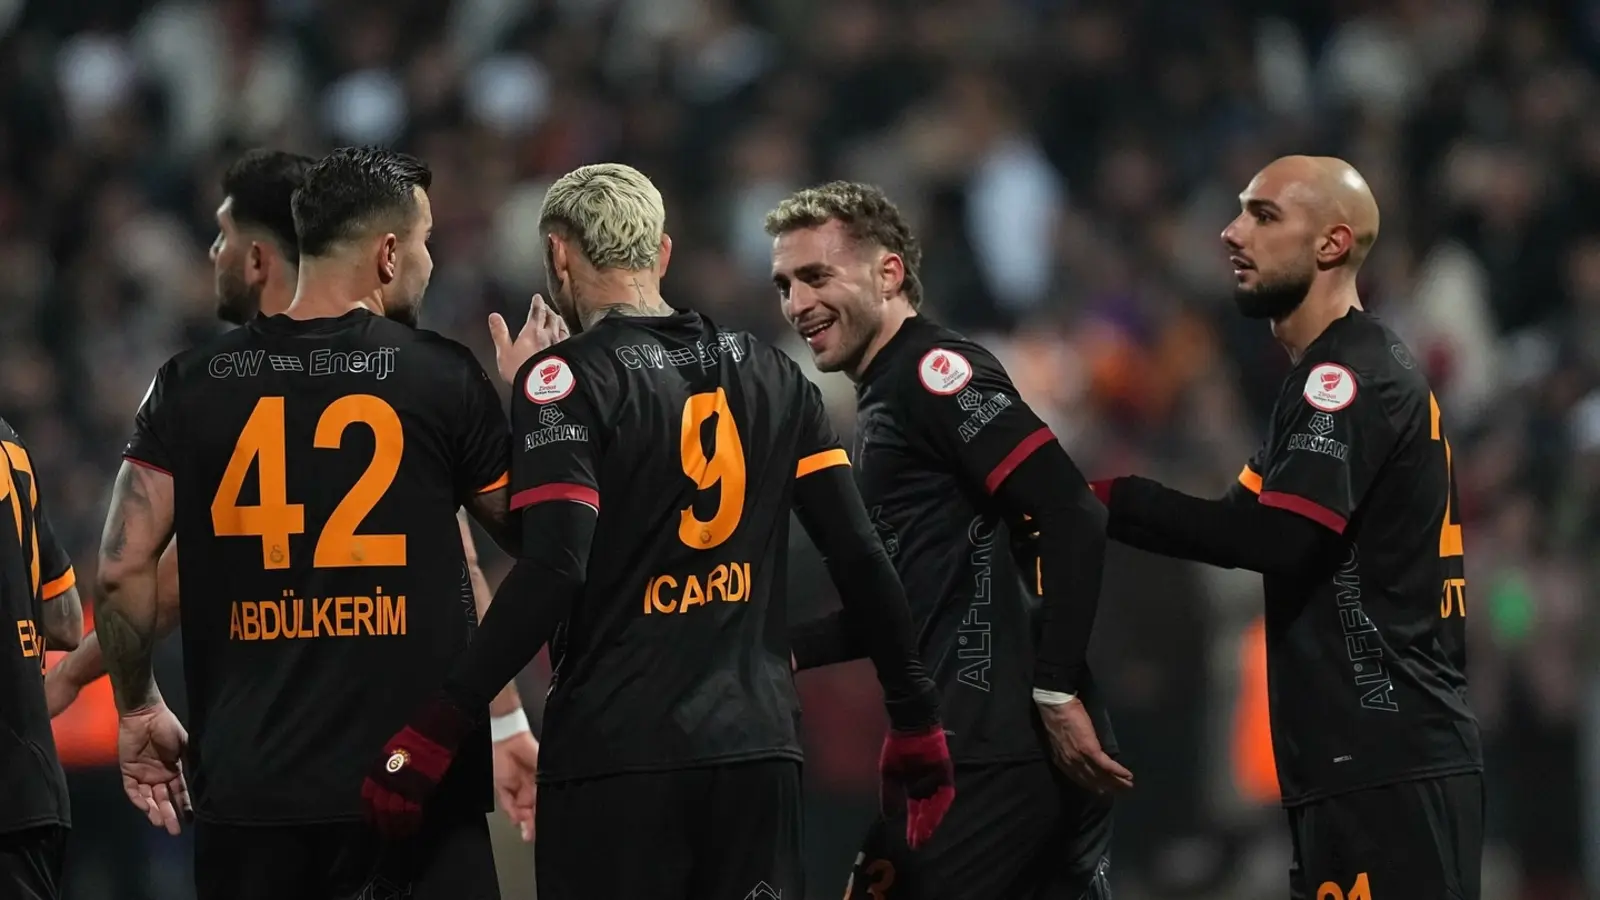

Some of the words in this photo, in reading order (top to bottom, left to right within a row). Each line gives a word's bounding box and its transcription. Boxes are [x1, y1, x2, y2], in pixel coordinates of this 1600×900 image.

[208, 350, 265, 378] CW
[309, 347, 396, 380] Enerji
[616, 344, 664, 370] CW
[524, 424, 589, 453] ARKHAM
[957, 391, 1013, 443] ARKHAM
[678, 387, 746, 550] 9
[1287, 433, 1349, 461] ARKHAM
[210, 394, 407, 569] 42
[230, 586, 407, 641] ABDÜLKERİM
[644, 562, 751, 614] ICARDI
